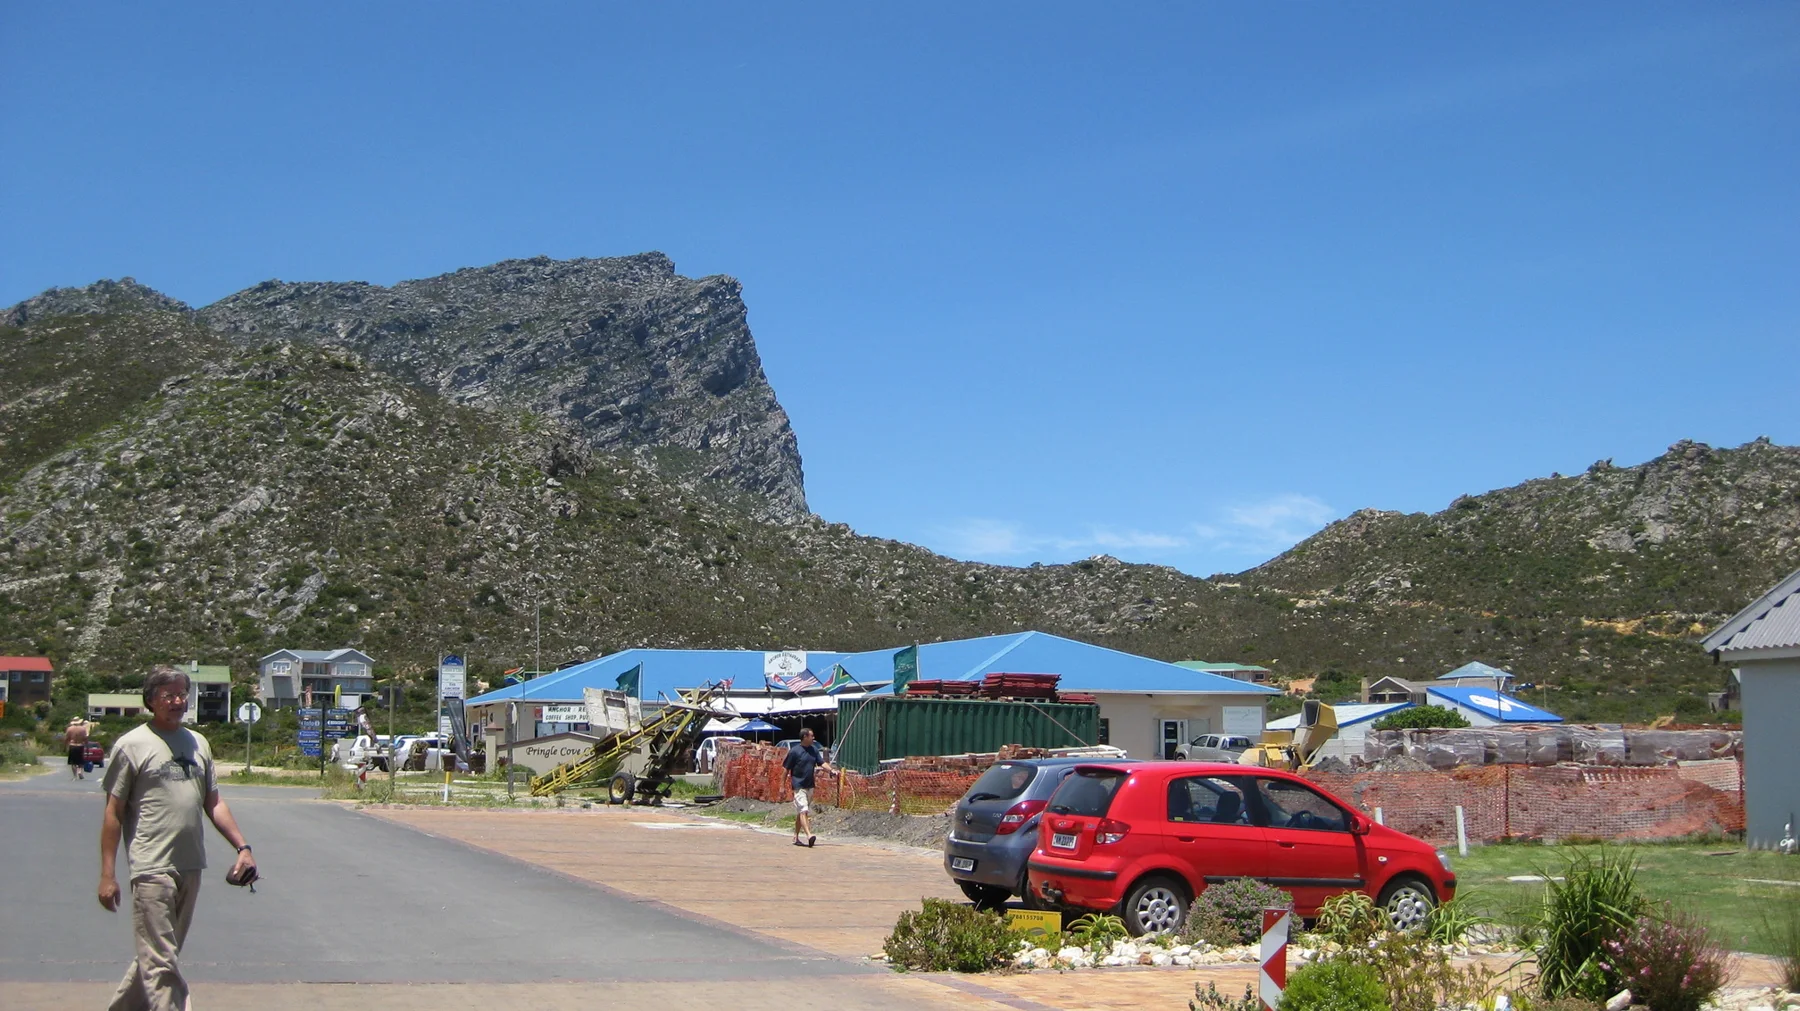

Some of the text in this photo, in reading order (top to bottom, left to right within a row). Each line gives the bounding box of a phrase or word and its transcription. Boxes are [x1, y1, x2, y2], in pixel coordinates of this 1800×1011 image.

[768, 653, 781, 664] ANCHOR
[526, 745, 557, 758] Pringle
[560, 747, 581, 756] Cove
